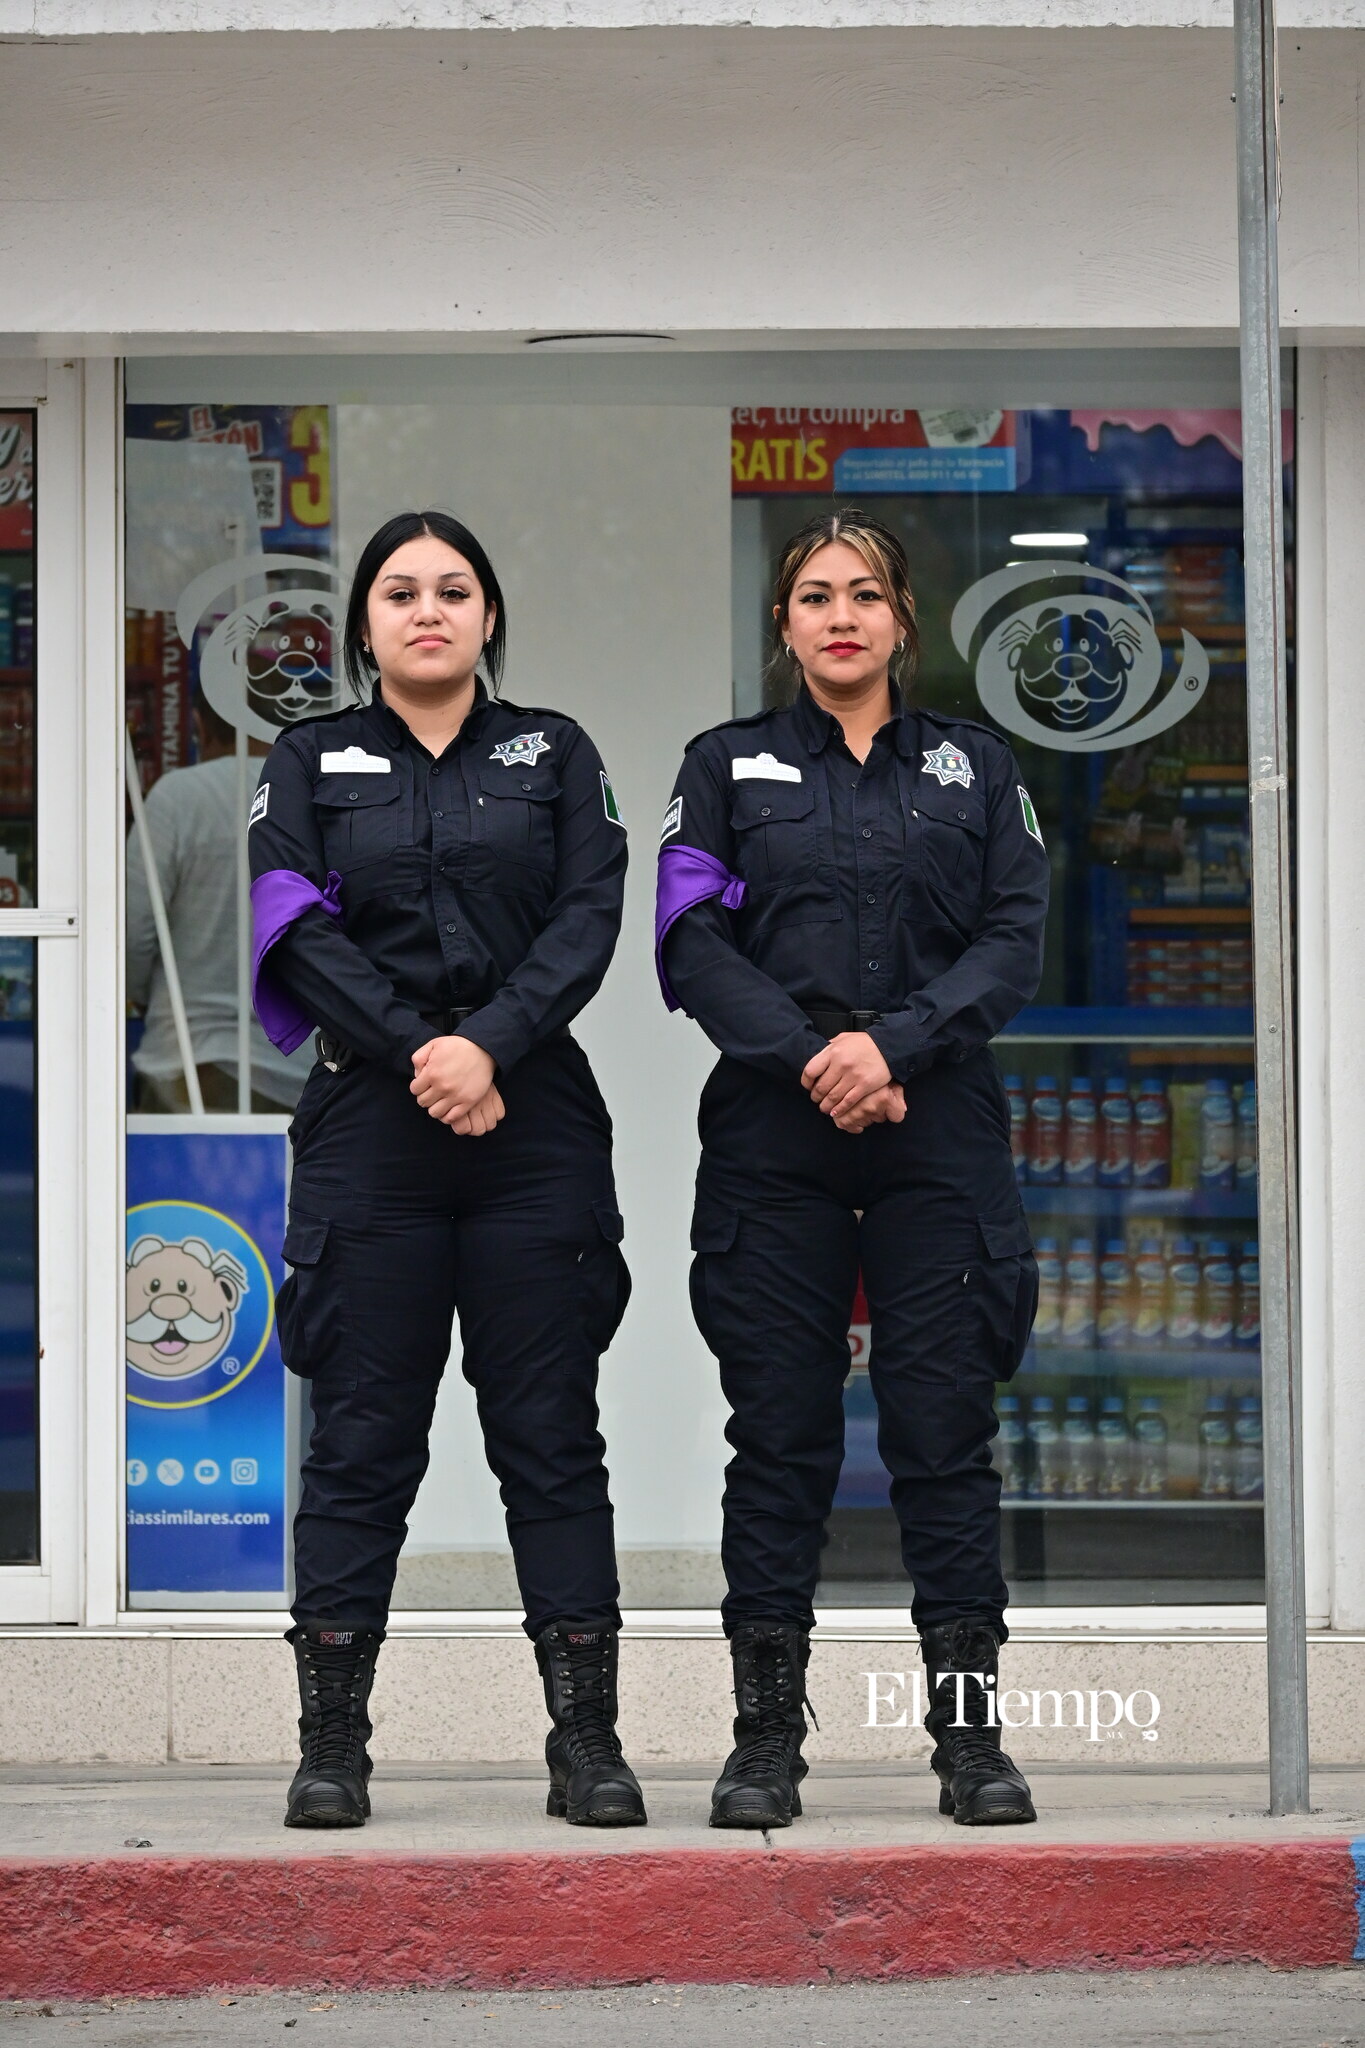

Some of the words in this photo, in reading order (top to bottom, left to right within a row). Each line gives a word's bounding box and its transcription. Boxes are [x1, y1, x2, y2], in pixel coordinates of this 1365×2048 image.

[732, 408, 766, 428] et,
[809, 408, 905, 431] compra
[127, 1509, 270, 1525] iassimilares.com
